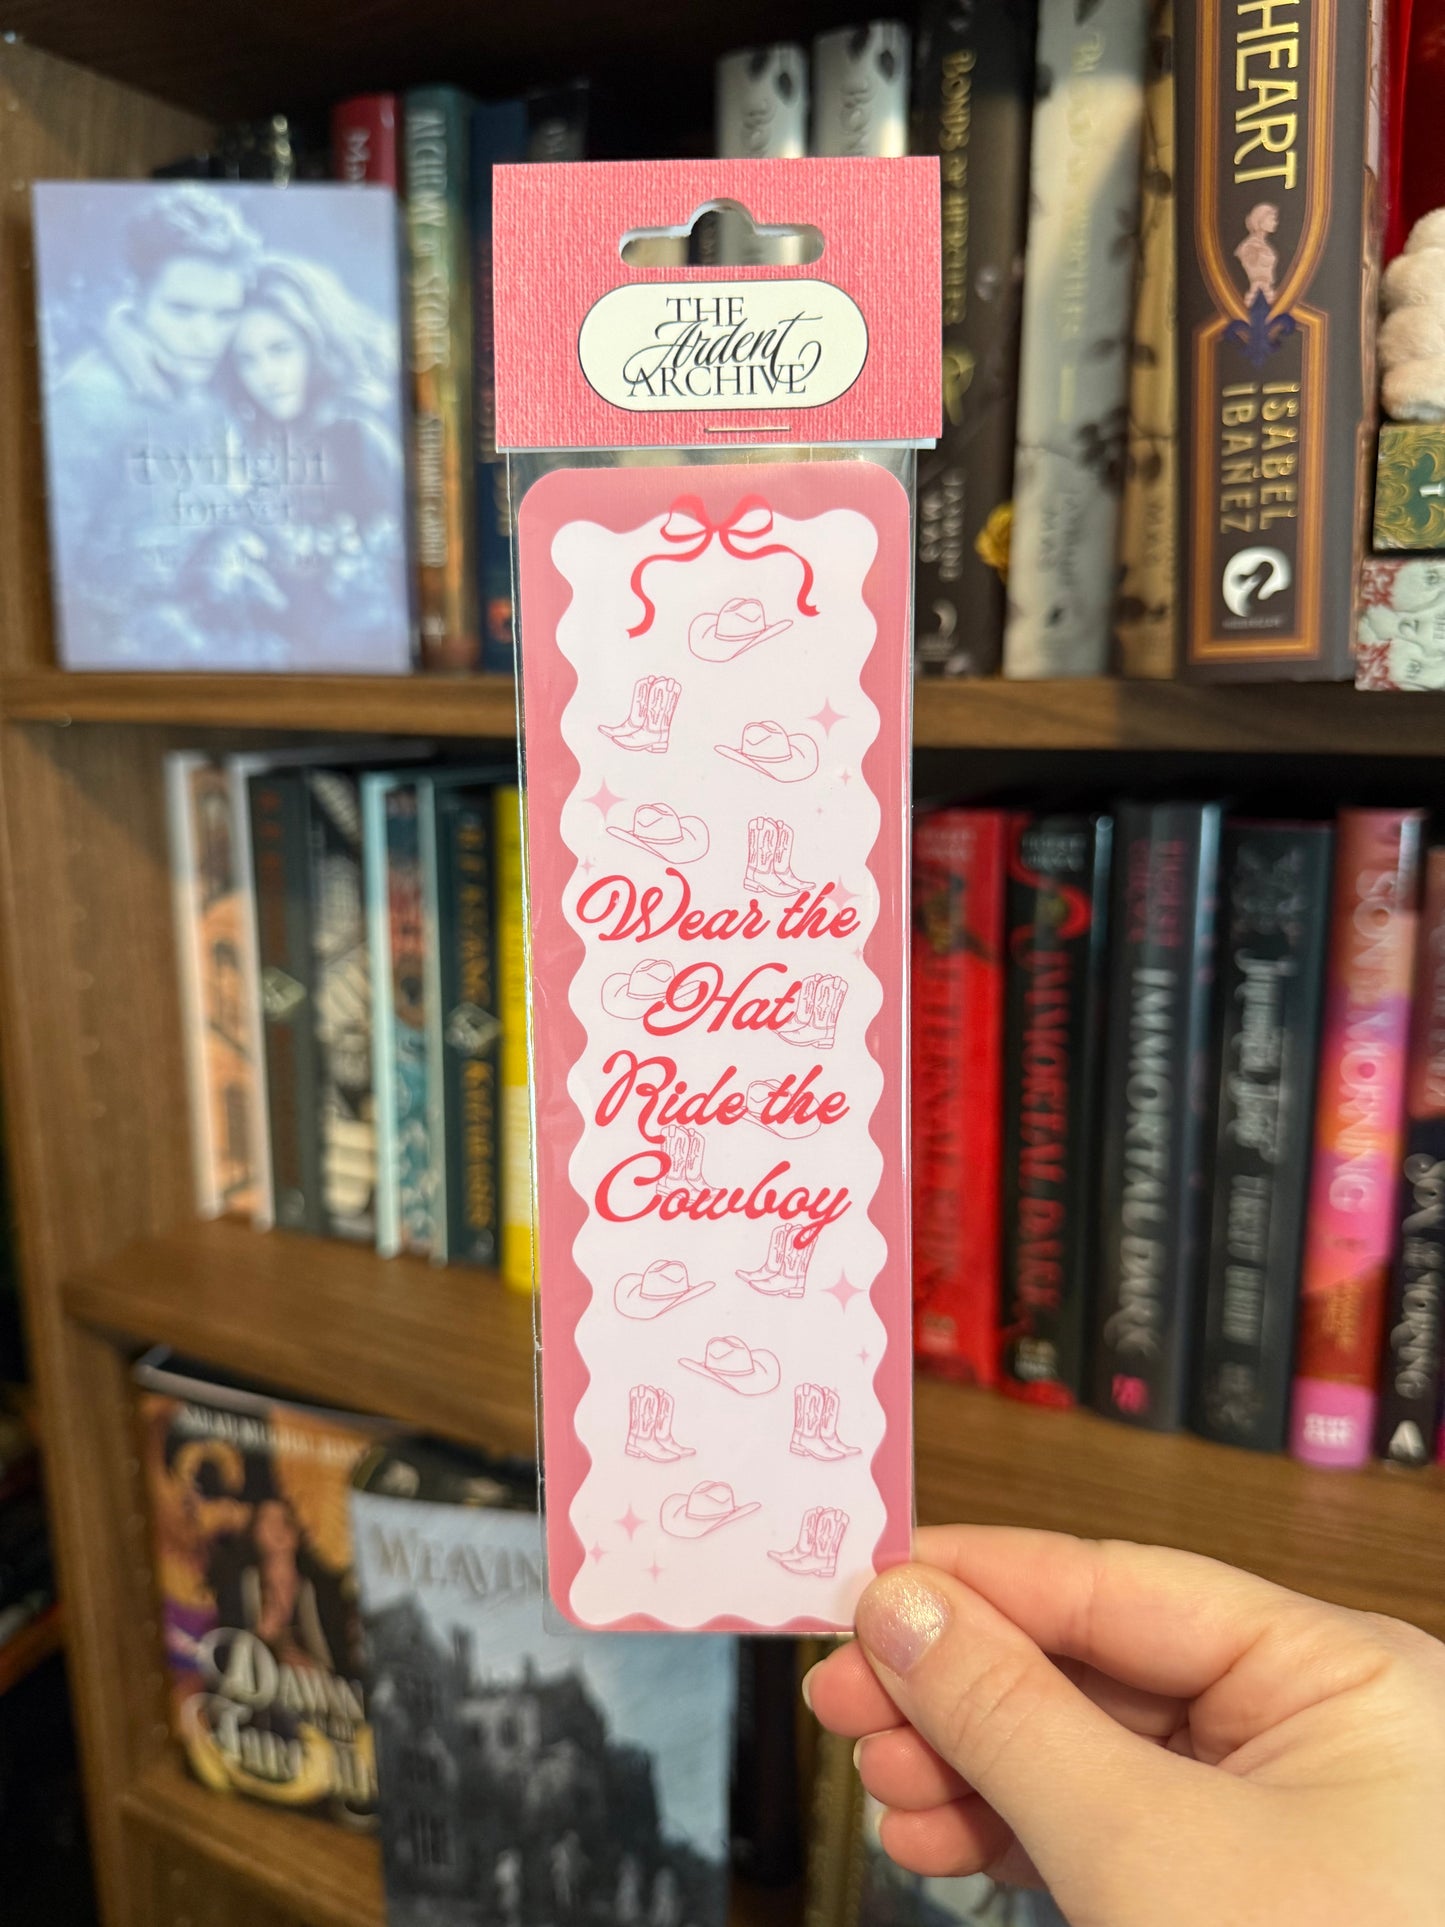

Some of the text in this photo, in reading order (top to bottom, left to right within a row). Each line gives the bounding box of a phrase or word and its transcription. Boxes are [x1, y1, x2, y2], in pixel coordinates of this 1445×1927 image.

[1234, 0, 1300, 190] HEART
[623, 311, 823, 384] Ardent
[666, 296, 745, 328] THE
[627, 363, 807, 397] ARCHIVE
[1260, 381, 1301, 531] ISABEL
[576, 867, 860, 943] Wear the
[643, 962, 802, 1036] Hat
[595, 1050, 850, 1144] Ride the
[1120, 968, 1178, 1234] IMMORTAL
[594, 1150, 853, 1250] Cowboy
[1103, 1235, 1167, 1362] DARK
